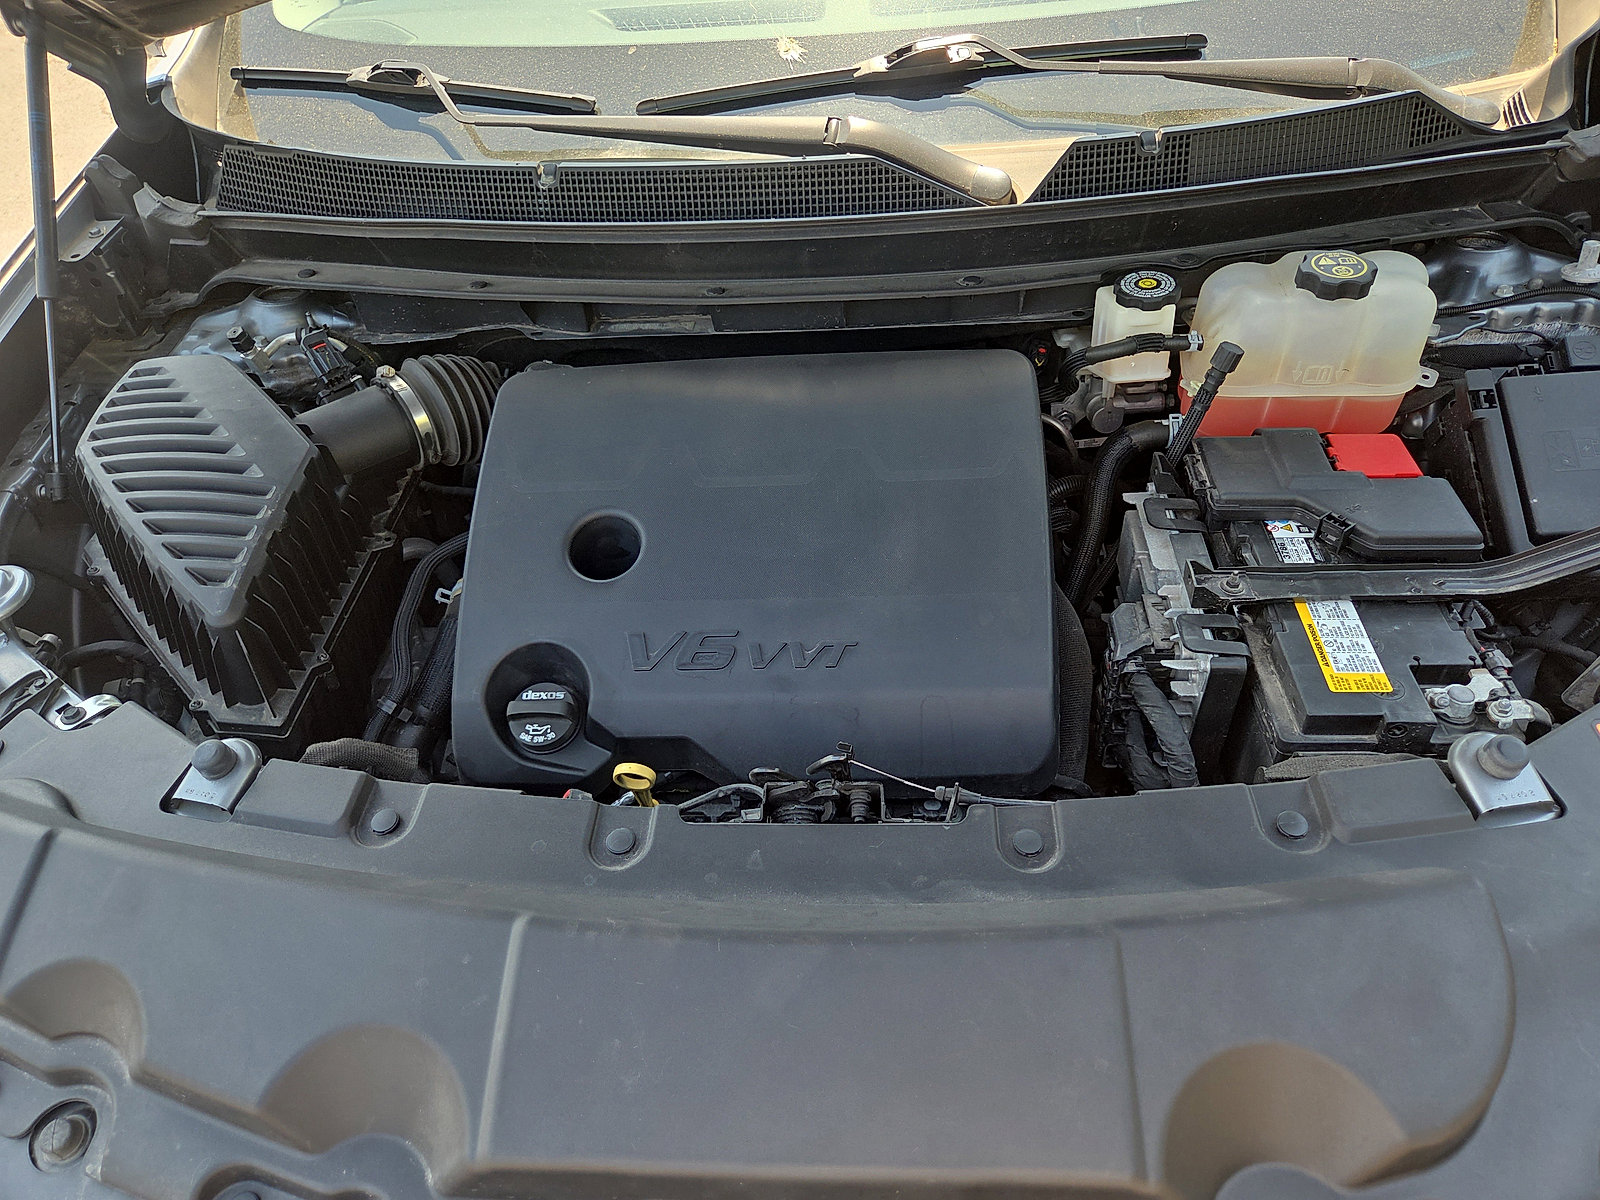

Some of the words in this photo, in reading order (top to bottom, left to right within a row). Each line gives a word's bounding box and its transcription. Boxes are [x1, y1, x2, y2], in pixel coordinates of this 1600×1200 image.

[625, 630, 739, 672] V6
[748, 639, 859, 670] VVT
[522, 690, 567, 700] dexos
[519, 732, 532, 742] SAE
[533, 731, 556, 743] 5W-30
